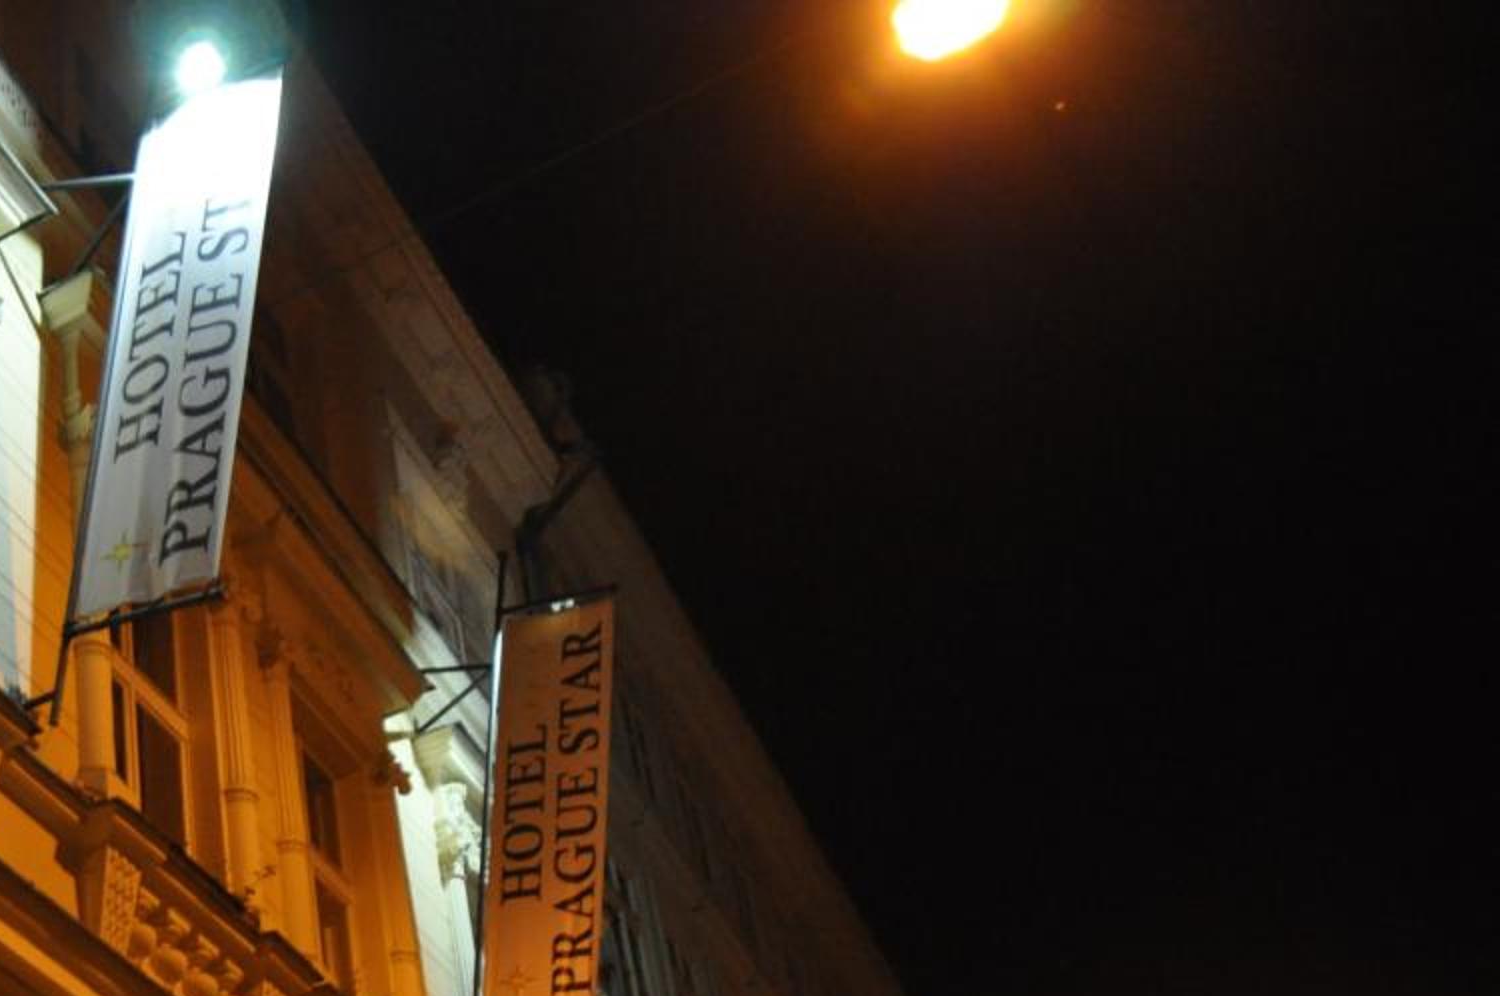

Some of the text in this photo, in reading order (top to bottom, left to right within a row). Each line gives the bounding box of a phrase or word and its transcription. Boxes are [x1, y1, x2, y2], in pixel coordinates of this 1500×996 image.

[113, 230, 186, 464] HOTEL
[158, 196, 251, 568] PRAGUE ST
[557, 620, 602, 755] STAR
[500, 723, 549, 907] HOTEL
